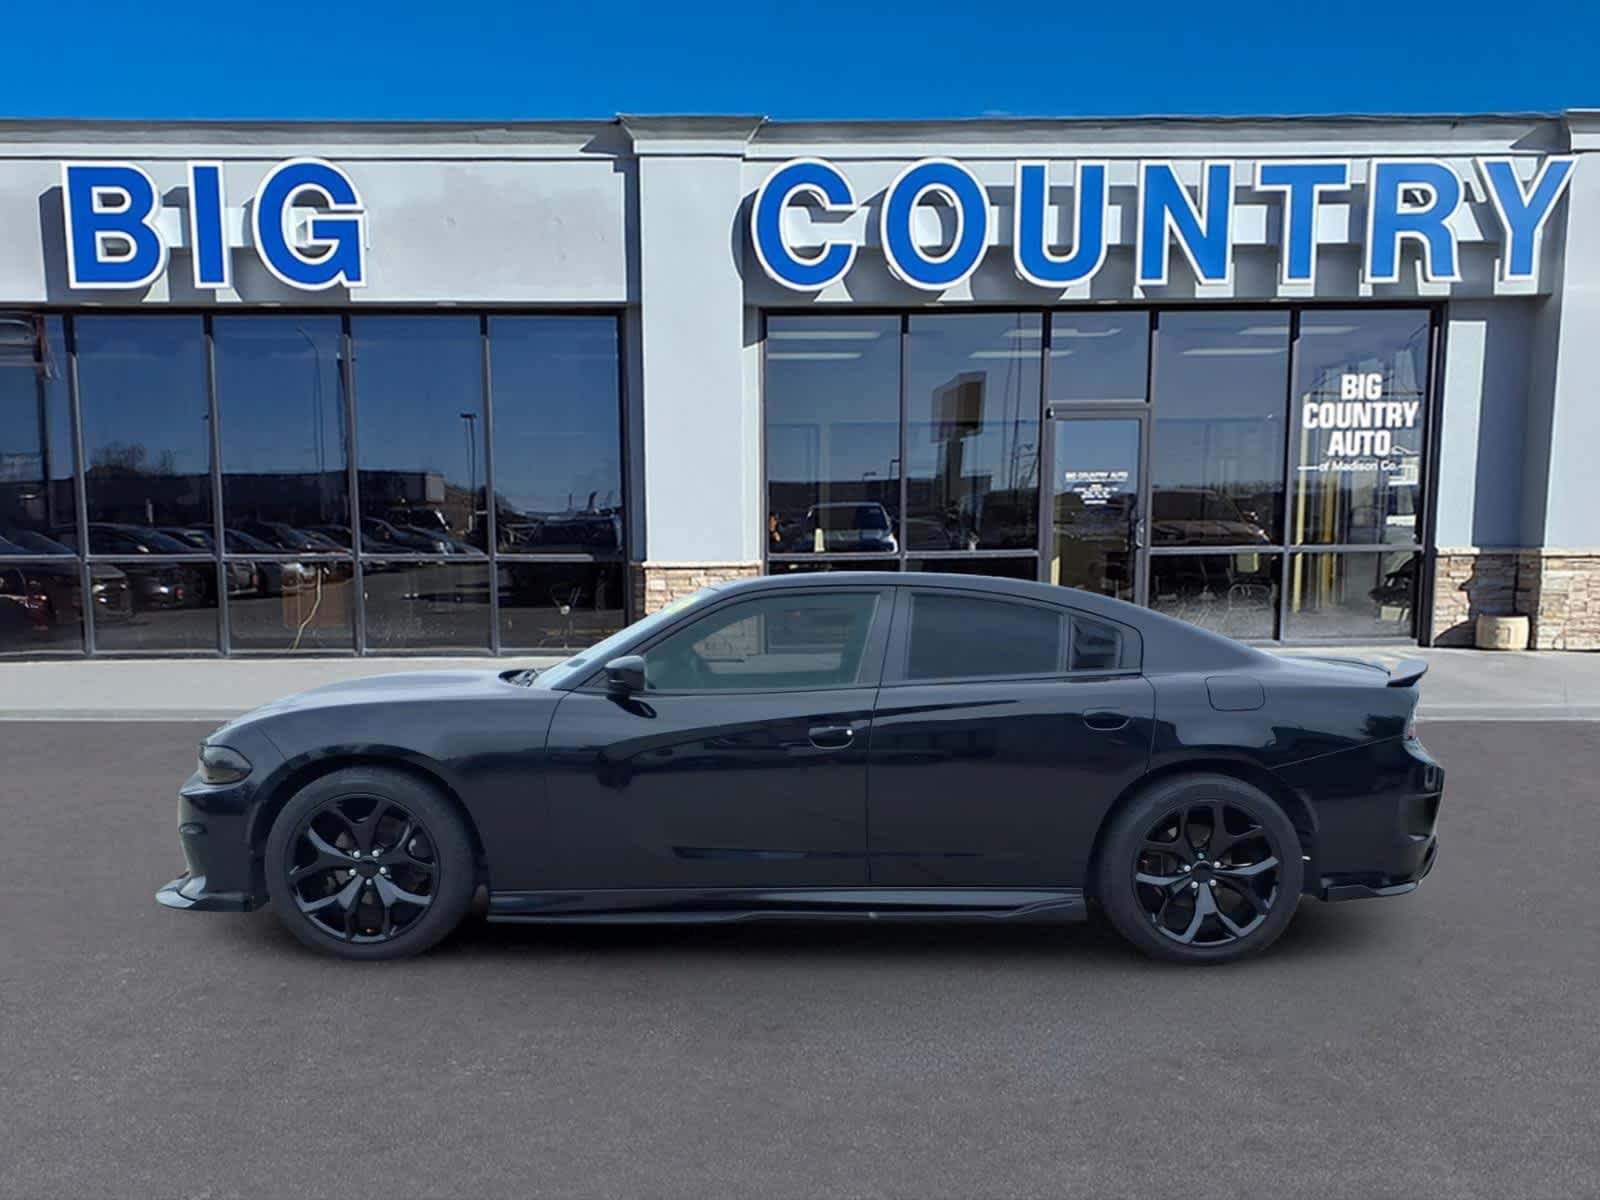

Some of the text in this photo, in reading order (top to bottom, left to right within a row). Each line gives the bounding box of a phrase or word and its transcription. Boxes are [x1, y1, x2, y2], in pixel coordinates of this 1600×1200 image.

[60, 157, 1576, 293] BIG COUNTRY
[1341, 373, 1383, 400] BIG
[1302, 401, 1420, 429] COUNTRY
[1327, 430, 1391, 456] AUTO
[1319, 460, 1329, 472] of
[1331, 460, 1378, 472] Madison
